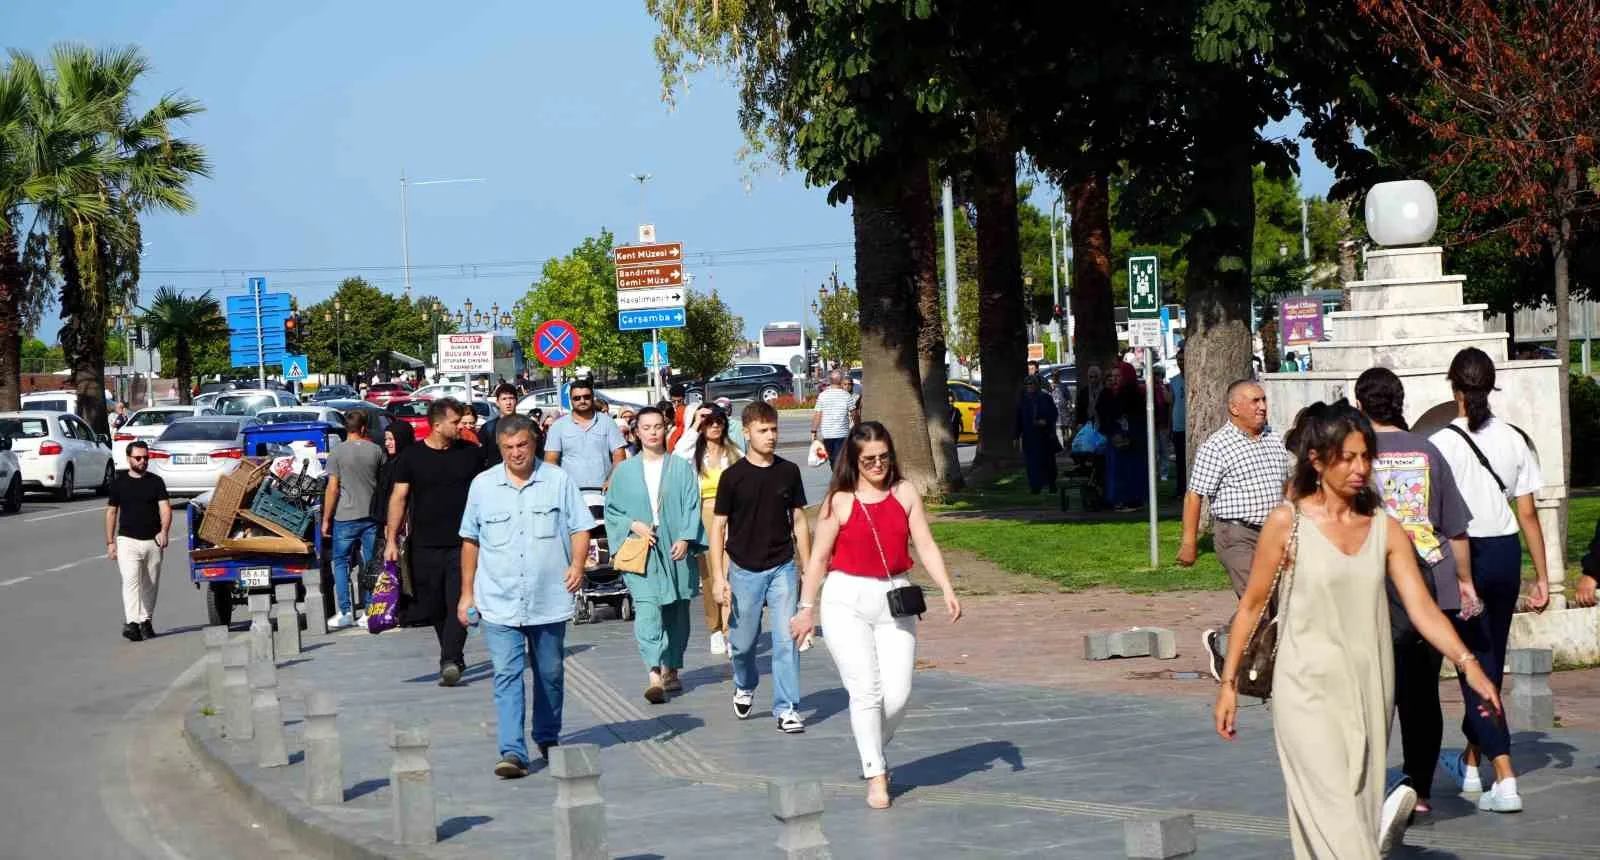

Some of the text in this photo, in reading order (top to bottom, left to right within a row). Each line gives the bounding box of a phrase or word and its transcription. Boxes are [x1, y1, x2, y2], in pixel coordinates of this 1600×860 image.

[616, 249, 667, 260] Kent Müzesi
[620, 268, 660, 277] Bandırma
